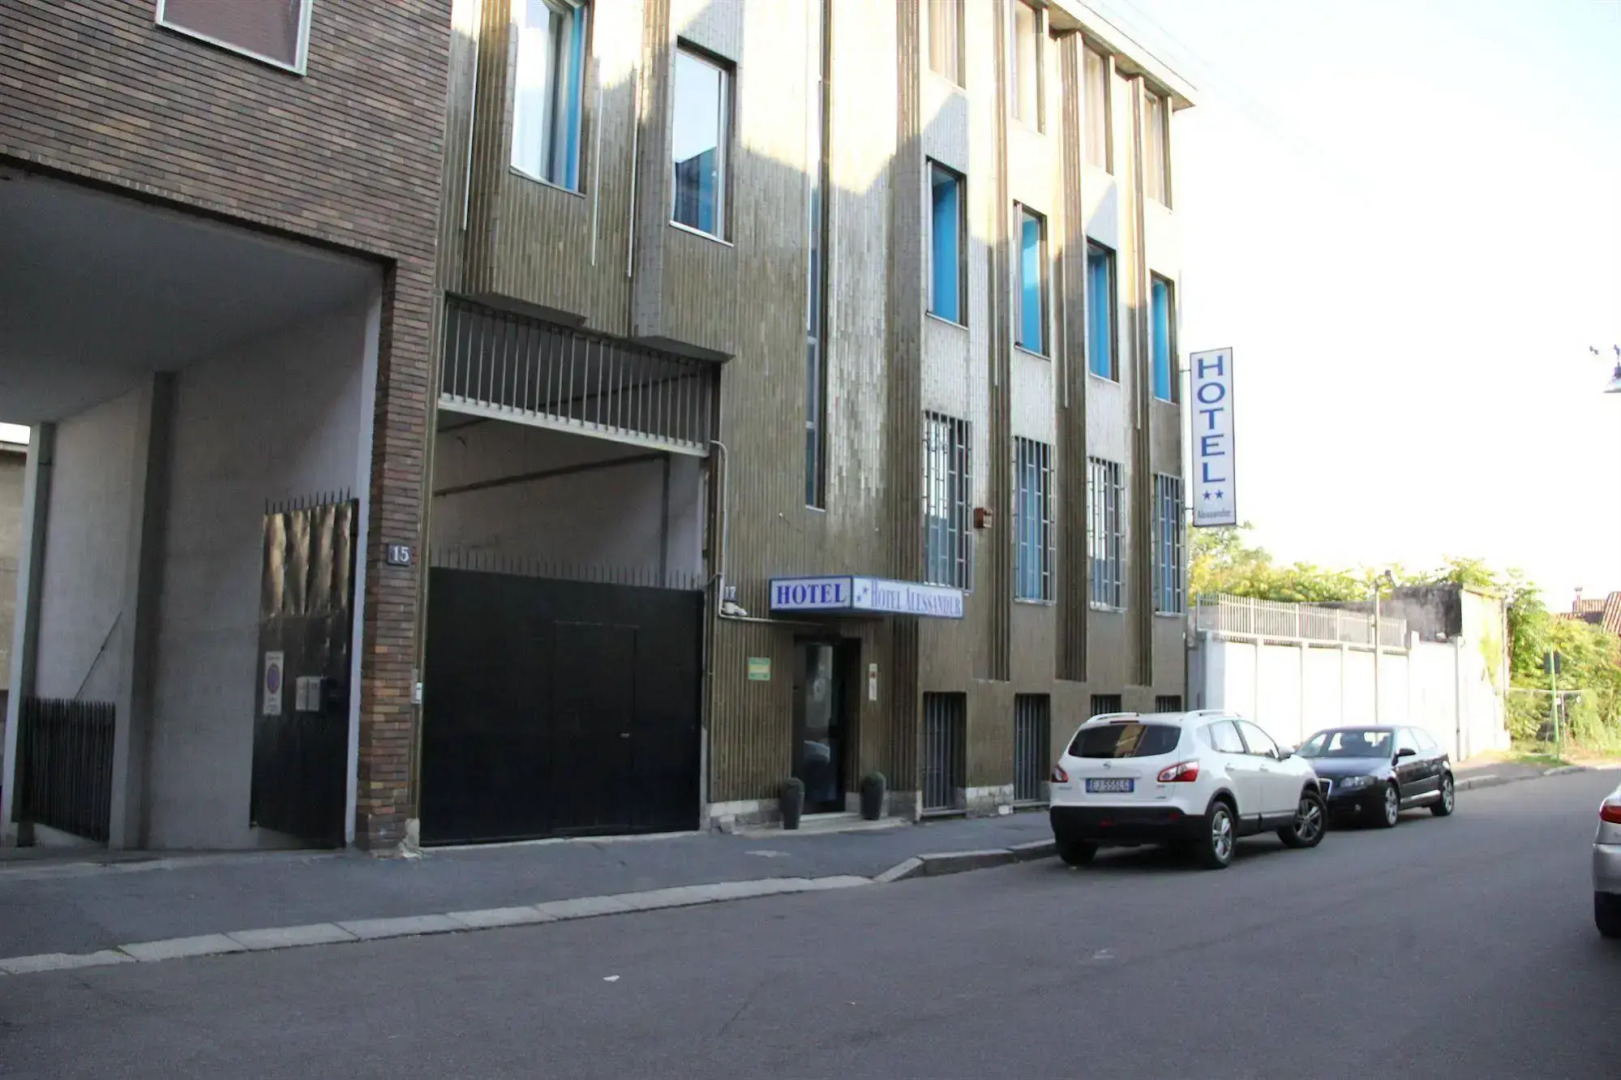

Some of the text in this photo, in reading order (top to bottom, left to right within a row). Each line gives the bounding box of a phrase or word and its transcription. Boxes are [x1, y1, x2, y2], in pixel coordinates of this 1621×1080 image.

[1197, 355, 1226, 484] HOTEL
[394, 545, 410, 562] 15
[776, 583, 847, 605] HOTEL
[870, 578, 901, 610] HOTEL
